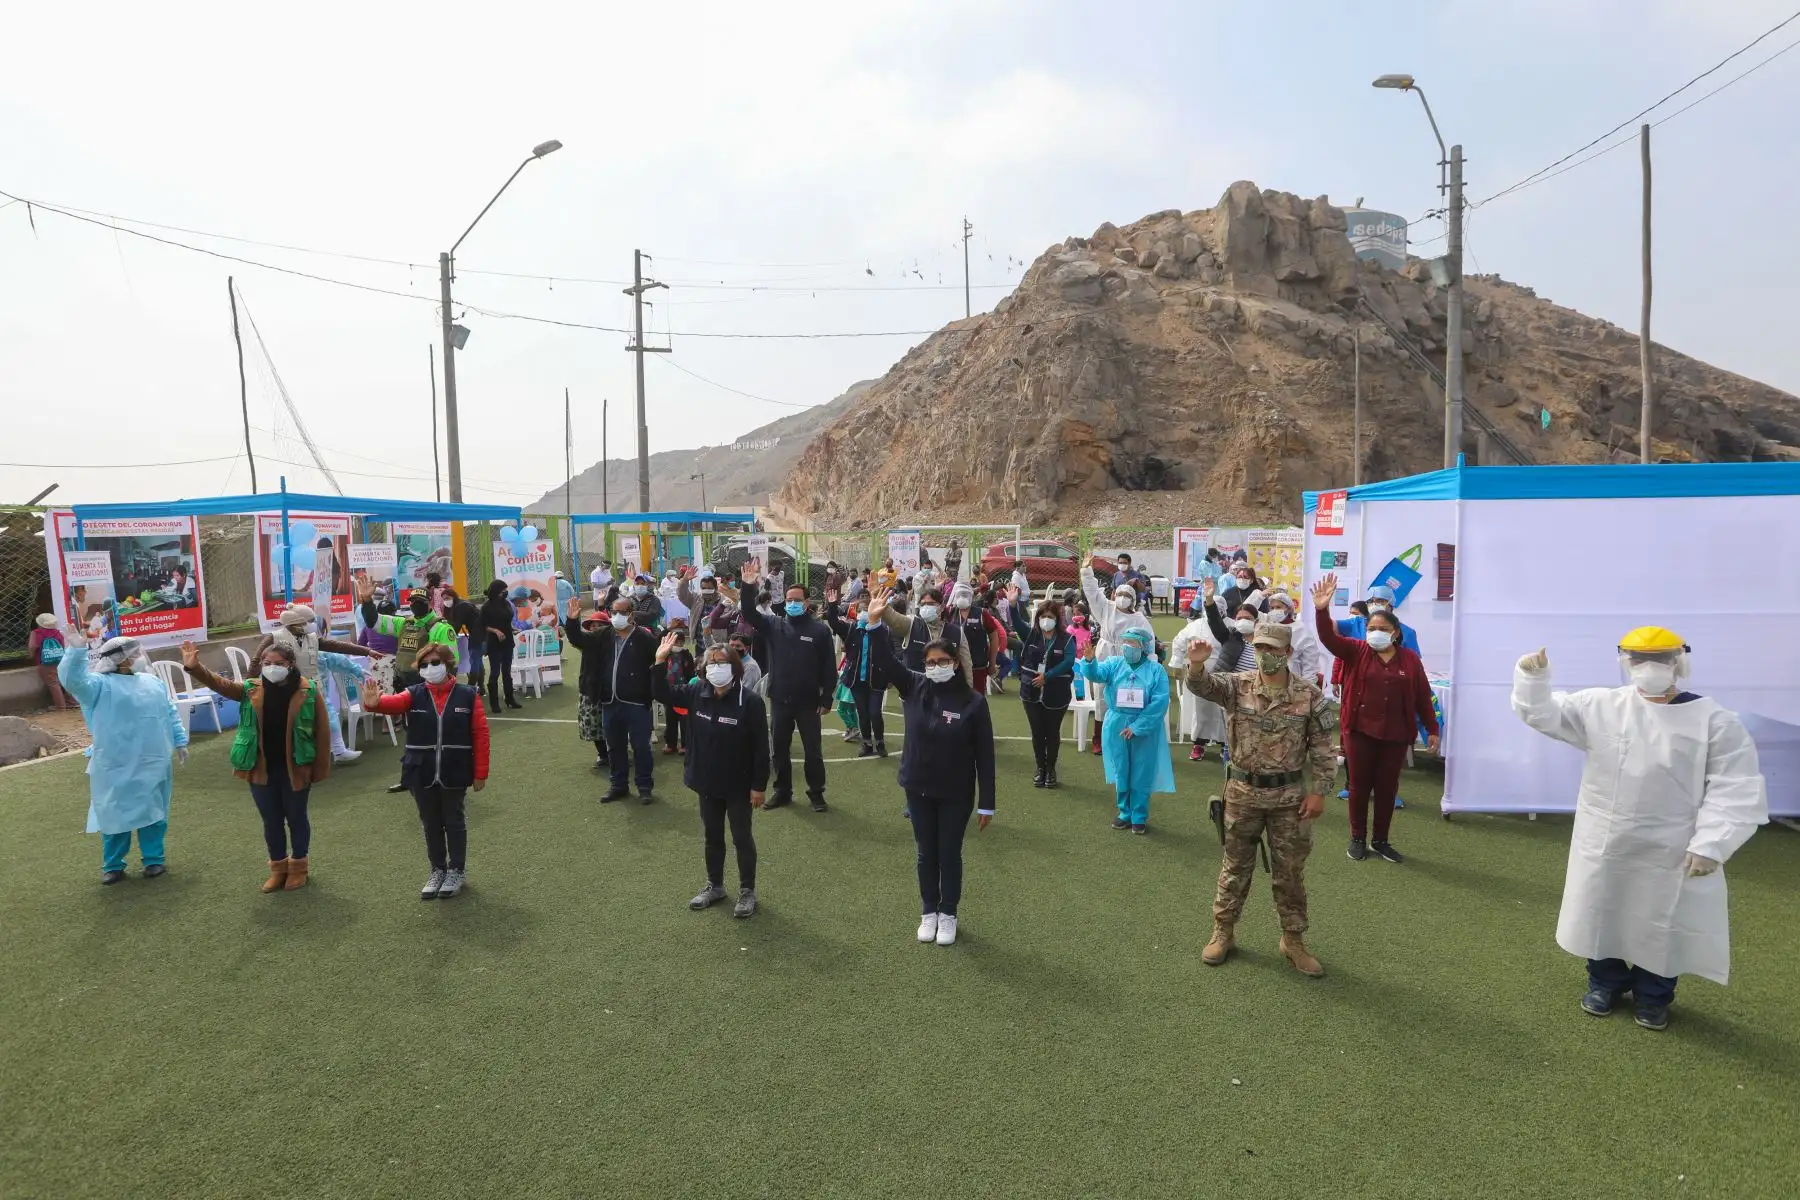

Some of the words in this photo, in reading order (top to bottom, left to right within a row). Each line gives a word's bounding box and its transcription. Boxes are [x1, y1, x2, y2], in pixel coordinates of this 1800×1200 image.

[501, 561, 550, 577] protege
[145, 614, 178, 623] distancia
[153, 622, 175, 632] hogar
